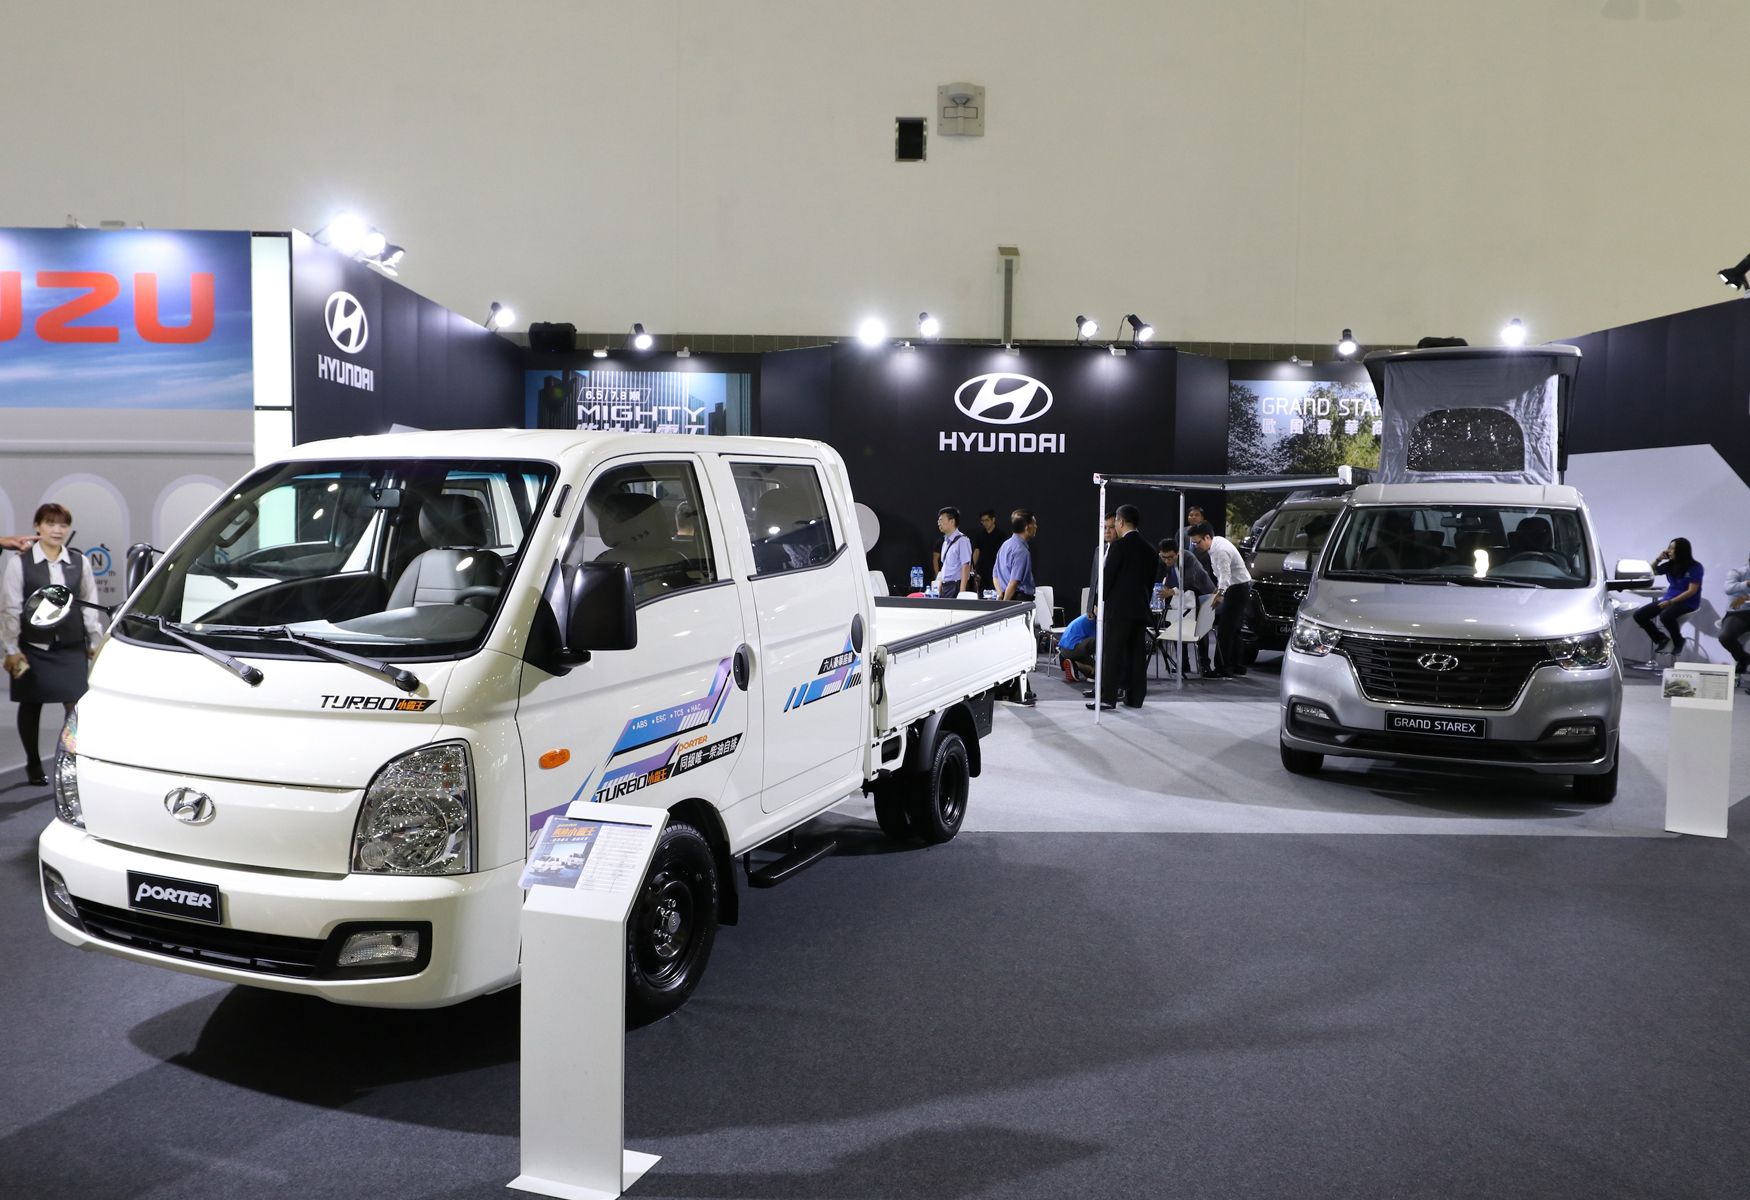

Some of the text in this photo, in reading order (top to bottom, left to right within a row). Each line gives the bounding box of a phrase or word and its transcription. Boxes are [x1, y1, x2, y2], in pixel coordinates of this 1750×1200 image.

[0, 271, 215, 343] ZU
[317, 353, 374, 392] HYUNDAI
[577, 404, 706, 422] MIGHTY
[1262, 397, 1330, 416] GRAND
[939, 431, 1066, 453] HYUNDAI
[320, 695, 427, 711] TURBO 小霸王
[636, 703, 702, 730] ABS ESC TCS HAC
[1394, 717, 1477, 733] GRAND STAREX
[677, 734, 708, 756] PORTER
[596, 772, 648, 804] TURBO
[135, 882, 212, 909] PORTER
